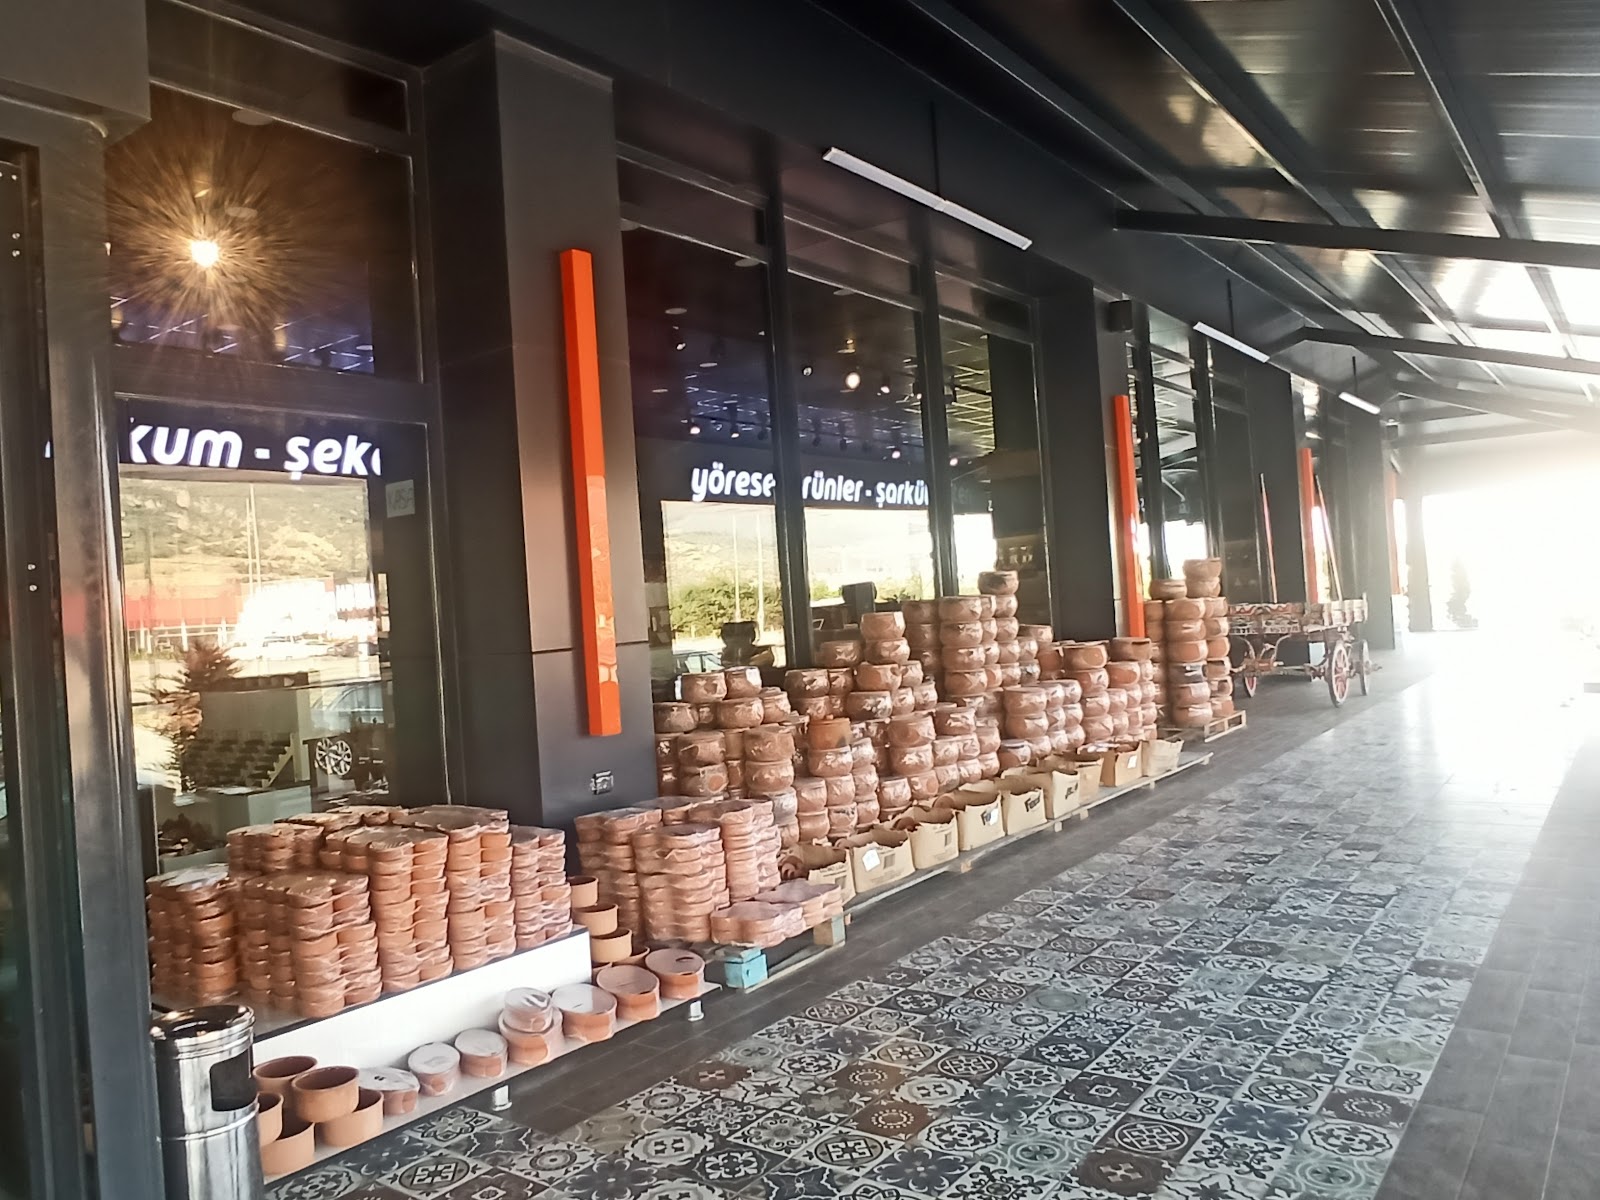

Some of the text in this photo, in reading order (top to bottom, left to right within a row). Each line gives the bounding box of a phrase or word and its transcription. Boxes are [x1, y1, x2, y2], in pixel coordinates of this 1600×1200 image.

[129, 416, 243, 468] kum
[691, 461, 776, 502] yörese
[802, 470, 864, 503] rünler
